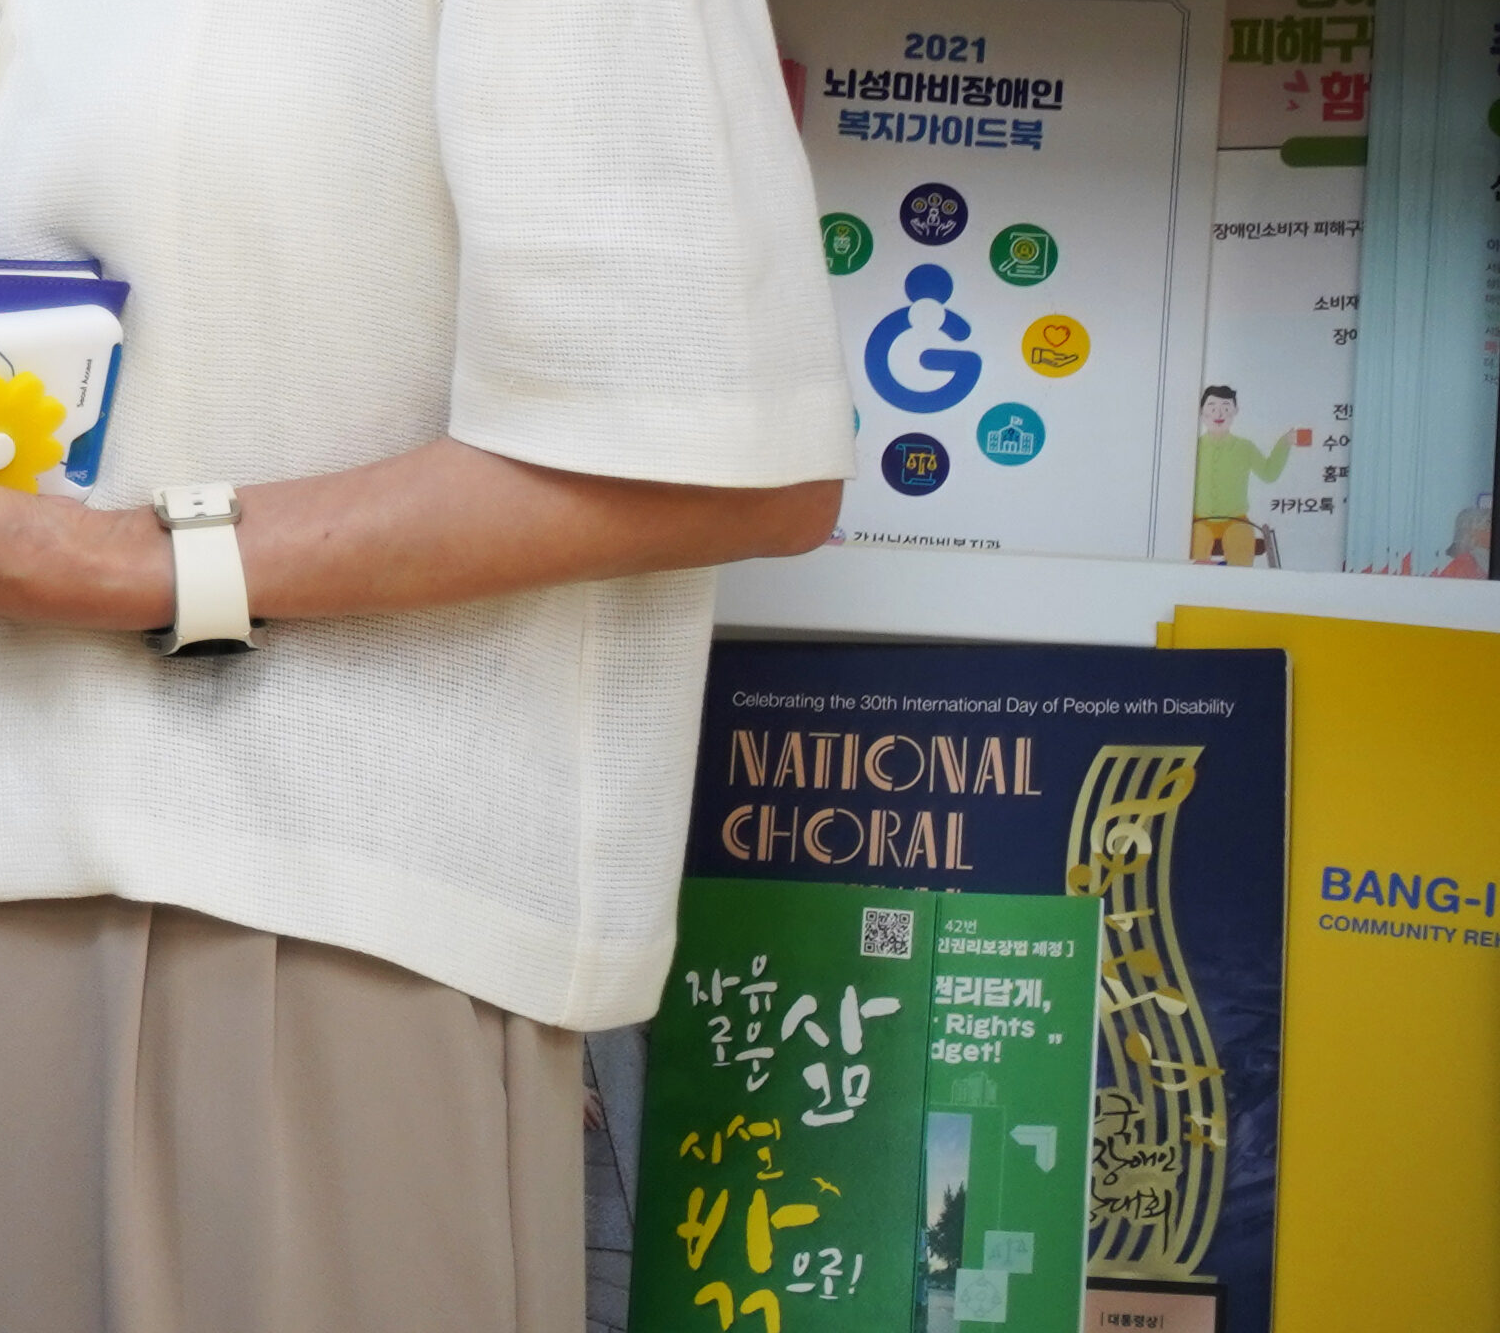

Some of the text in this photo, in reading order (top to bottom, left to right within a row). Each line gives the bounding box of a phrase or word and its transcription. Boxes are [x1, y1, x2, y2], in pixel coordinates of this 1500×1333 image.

[903, 32, 987, 64] 2021
[1228, 14, 1375, 65] 피해구
[823, 68, 1065, 111] 뇌성마비장애인
[837, 108, 1044, 151] 복지가이드북
[1212, 219, 1365, 242] 장애인소비자 피해구
[1332, 403, 1354, 422] 전
[1270, 497, 1335, 515] 카카오톡
[731, 691, 1236, 718] Celebrating the 30th International Day of People with Disability
[728, 729, 1043, 796] NATIONAL
[721, 804, 975, 871] CHORAL
[944, 919, 977, 935] 42번
[1318, 913, 1457, 944] COMMUNITY
[945, 1013, 1036, 1040] Rights
[780, 984, 902, 1127] 삶
[679, 1114, 784, 1181] 시설
[675, 1187, 821, 1333] 밖
[1107, 1313, 1160, 1330] 대통령상
